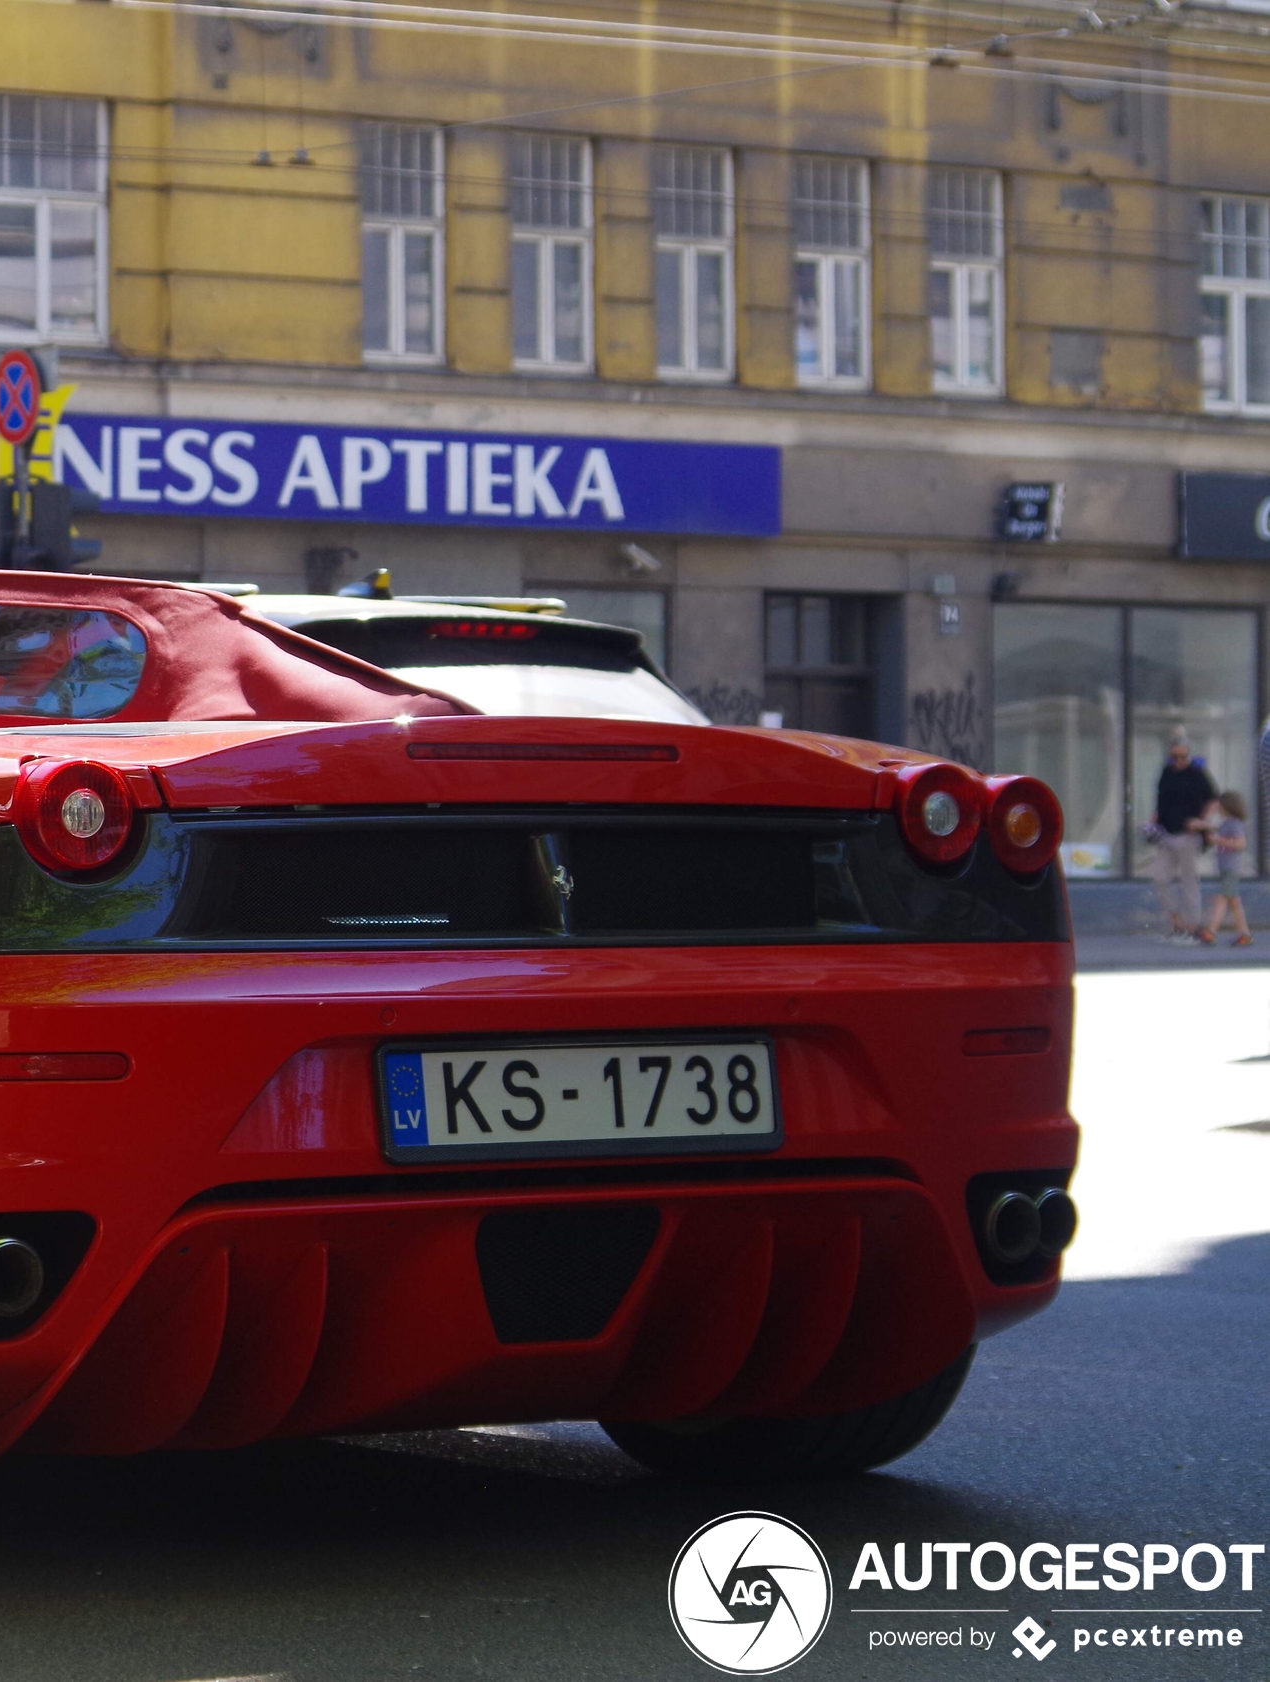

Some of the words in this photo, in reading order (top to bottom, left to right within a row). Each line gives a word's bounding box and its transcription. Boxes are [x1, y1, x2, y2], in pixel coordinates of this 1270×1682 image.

[279, 435, 625, 521] APTIEKA
[394, 1110, 422, 1130] LV
[442, 1055, 760, 1134] KS-1738
